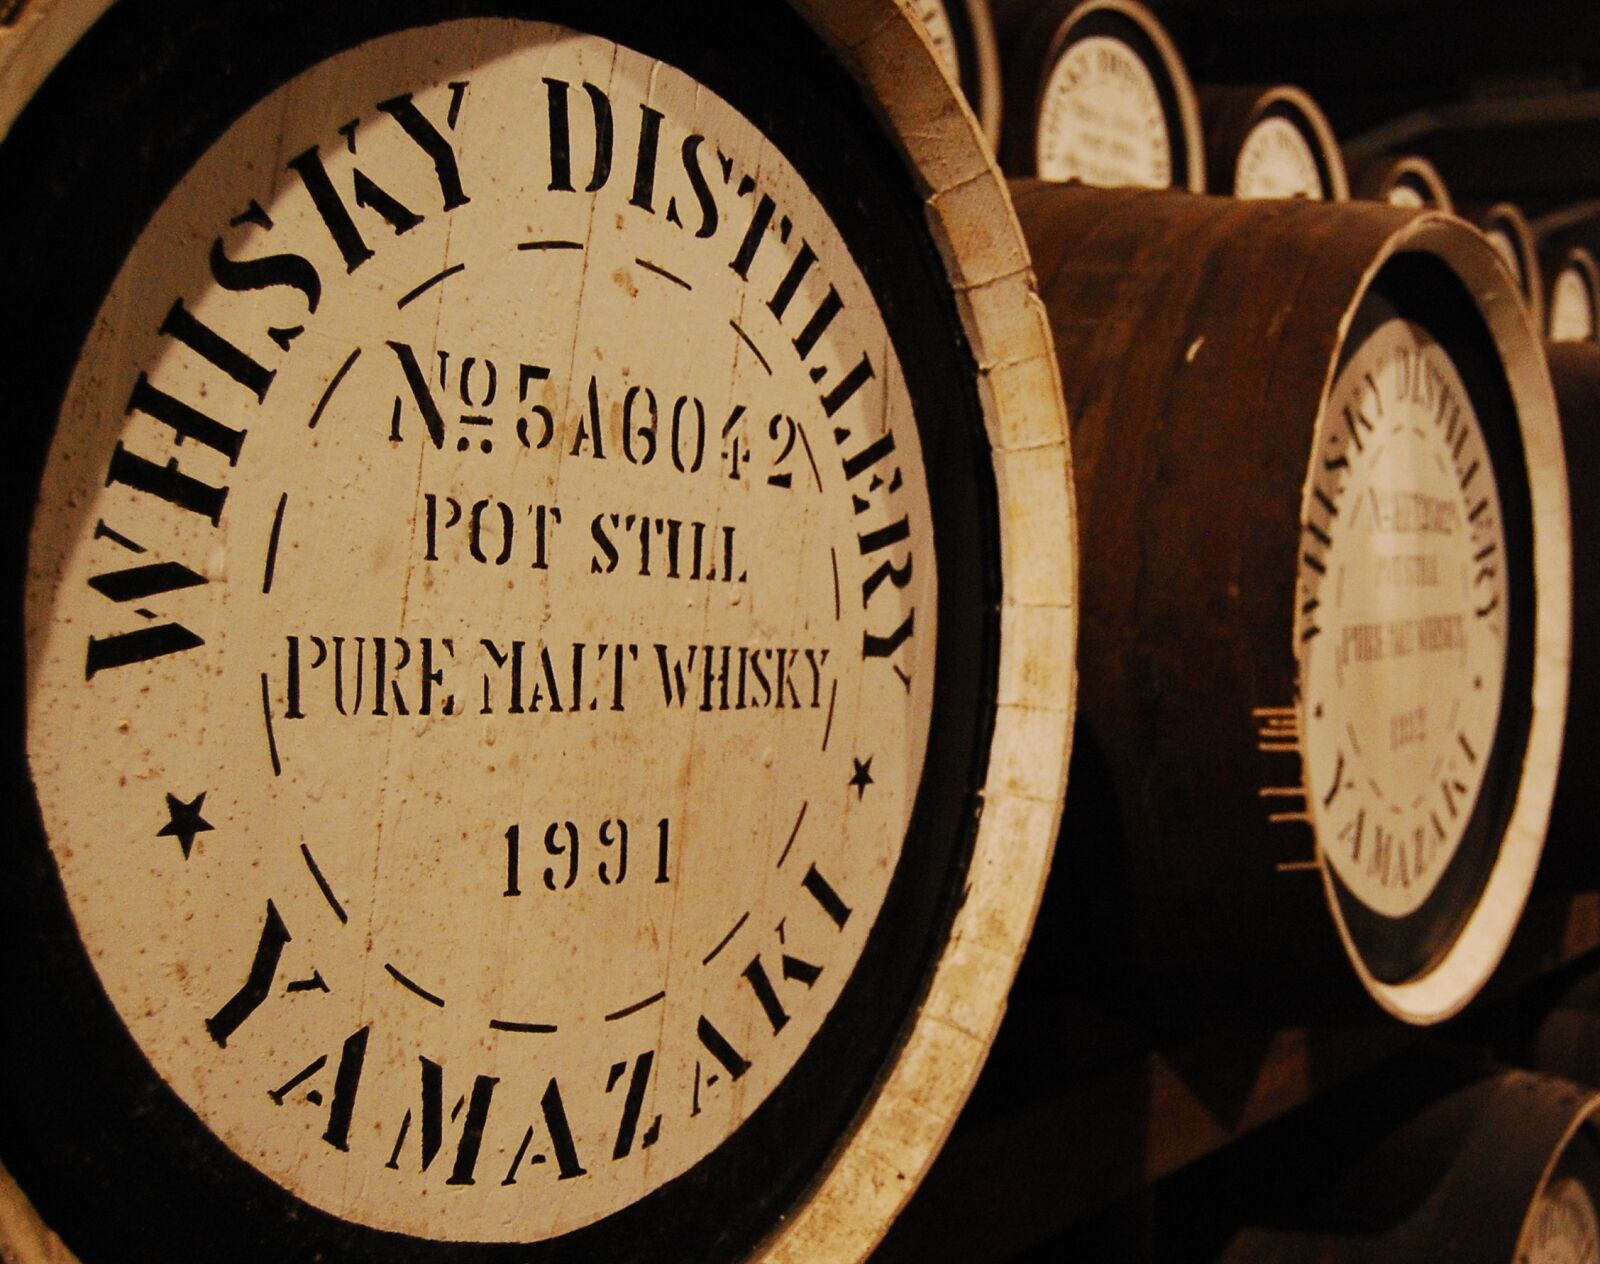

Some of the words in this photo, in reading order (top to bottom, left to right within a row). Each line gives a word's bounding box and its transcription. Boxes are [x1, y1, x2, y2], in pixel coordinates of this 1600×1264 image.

[85, 81, 471, 682] WHISKY
[541, 76, 915, 696] DISTILLERY
[424, 493, 562, 570] POT
[590, 512, 748, 583] STILL
[284, 635, 456, 719] PURE
[480, 638, 639, 716] MALT
[654, 643, 831, 713] WHISKY
[503, 818, 671, 898] 1991
[204, 861, 853, 1187] YAMAZAKI
